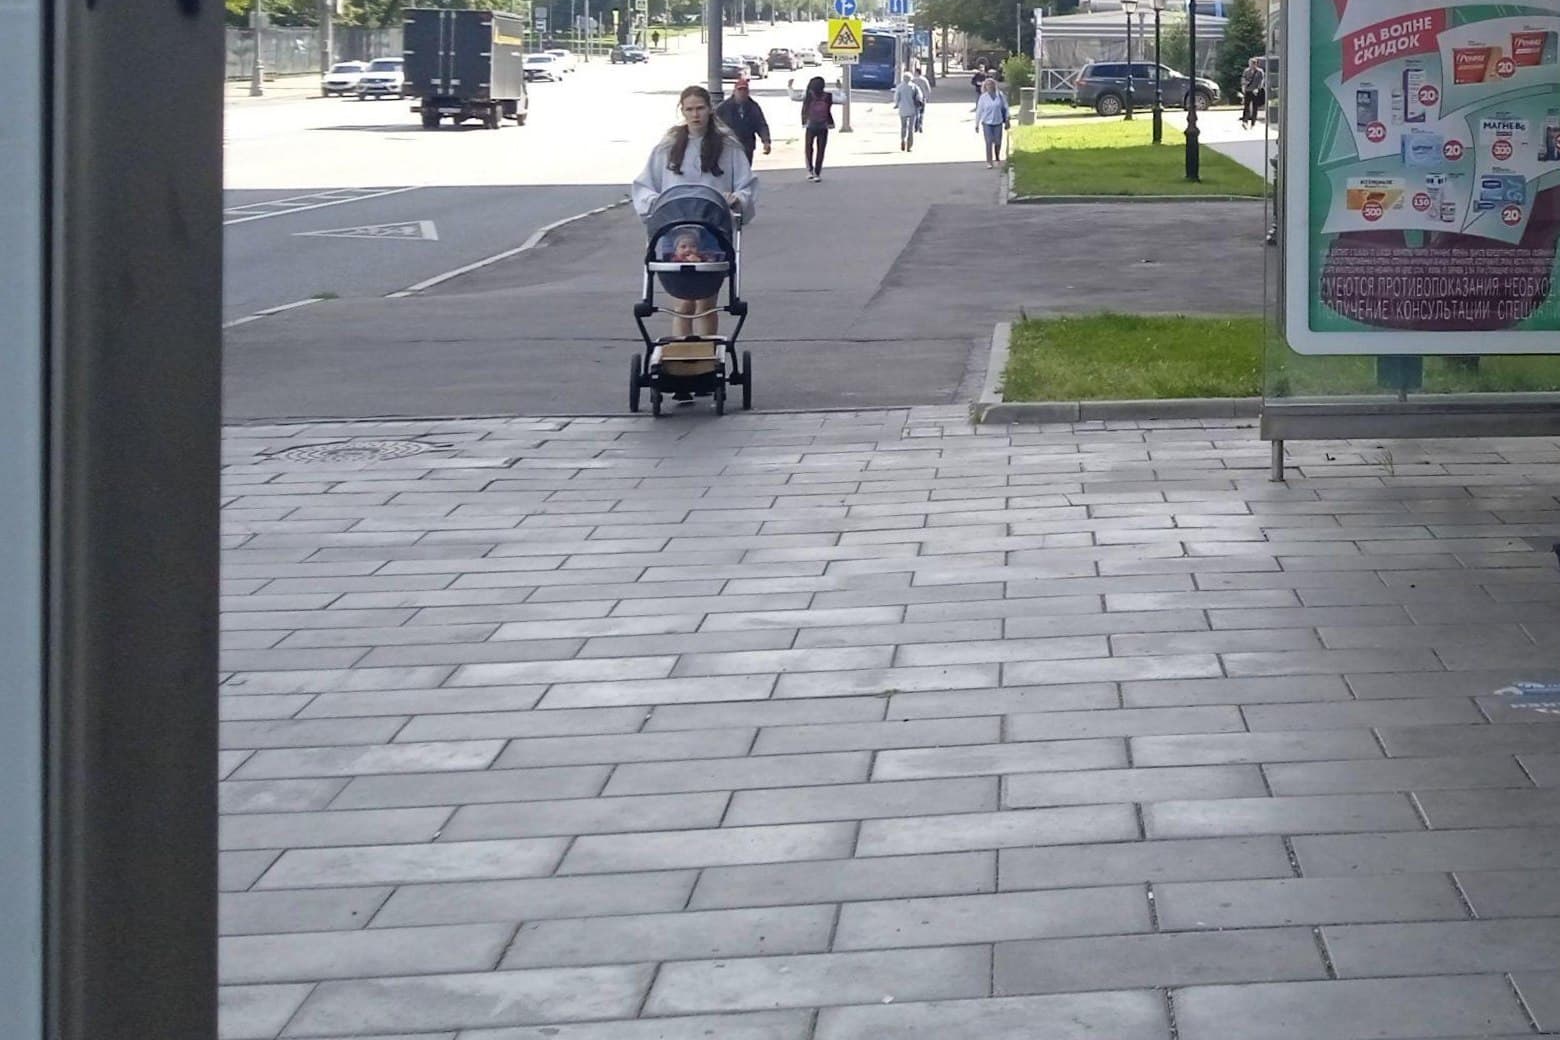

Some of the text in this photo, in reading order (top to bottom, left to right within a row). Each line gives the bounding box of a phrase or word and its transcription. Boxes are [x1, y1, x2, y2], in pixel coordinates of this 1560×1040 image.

[1354, 16, 1432, 51] НА ВОЛНЕ
[1354, 34, 1420, 65] СКИДОК
[1378, 276, 1500, 297] ПРОТИВОПОКАЗАНИЯ
[1396, 300, 1490, 320] КОНСУЛЬТАЦИИ
